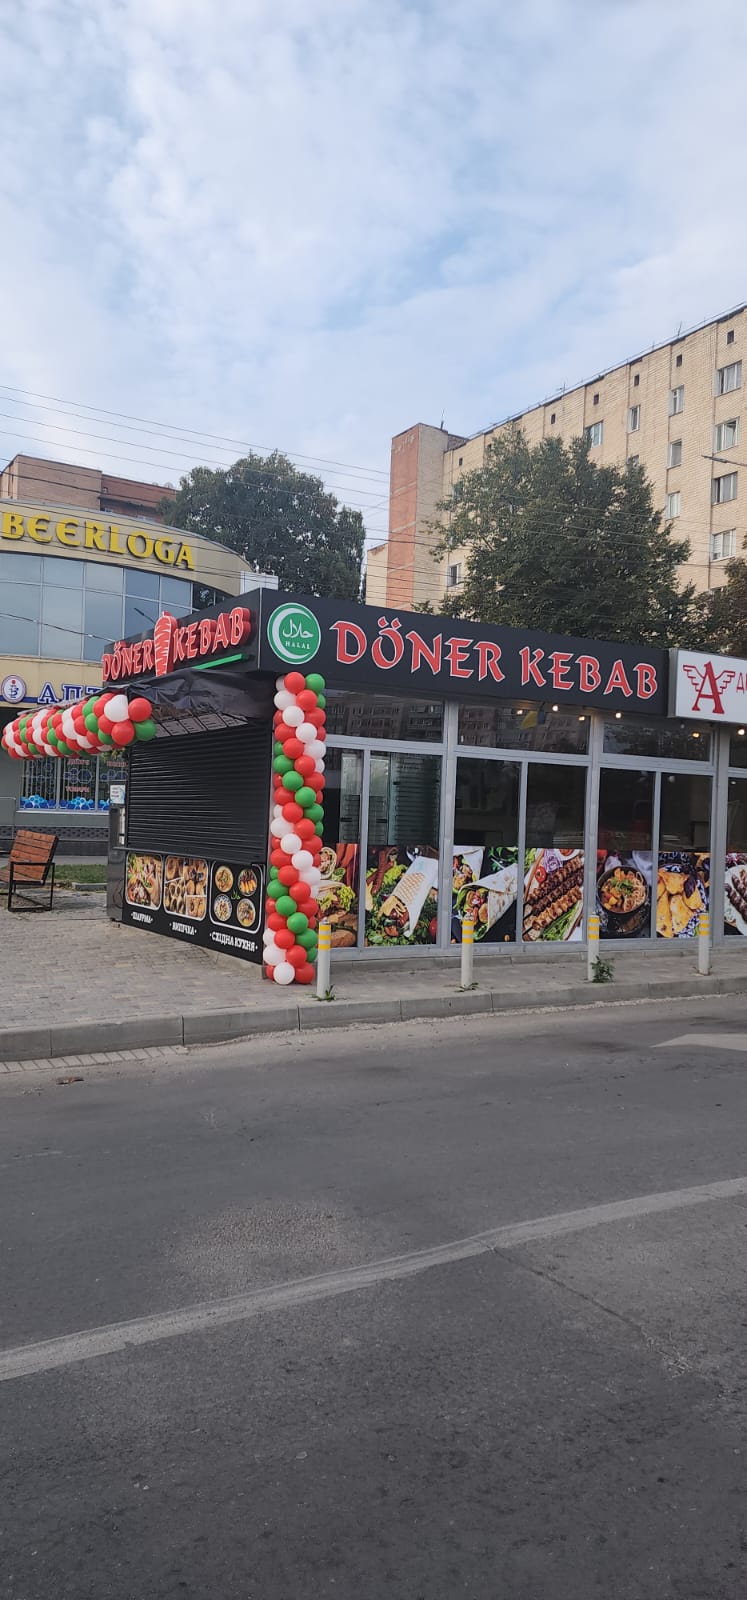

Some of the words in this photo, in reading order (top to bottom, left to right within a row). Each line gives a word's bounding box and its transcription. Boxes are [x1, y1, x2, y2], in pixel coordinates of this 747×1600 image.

[1, 512, 196, 571] BEERLOGA
[102, 639, 155, 682] DÖNER
[173, 607, 251, 664] KEBAB
[282, 619, 314, 638] حلال
[285, 640, 311, 650] HALAL
[329, 616, 505, 682] DÖNER
[519, 646, 658, 699] KEBAB
[234, 937, 256, 953] КУХНЯ
